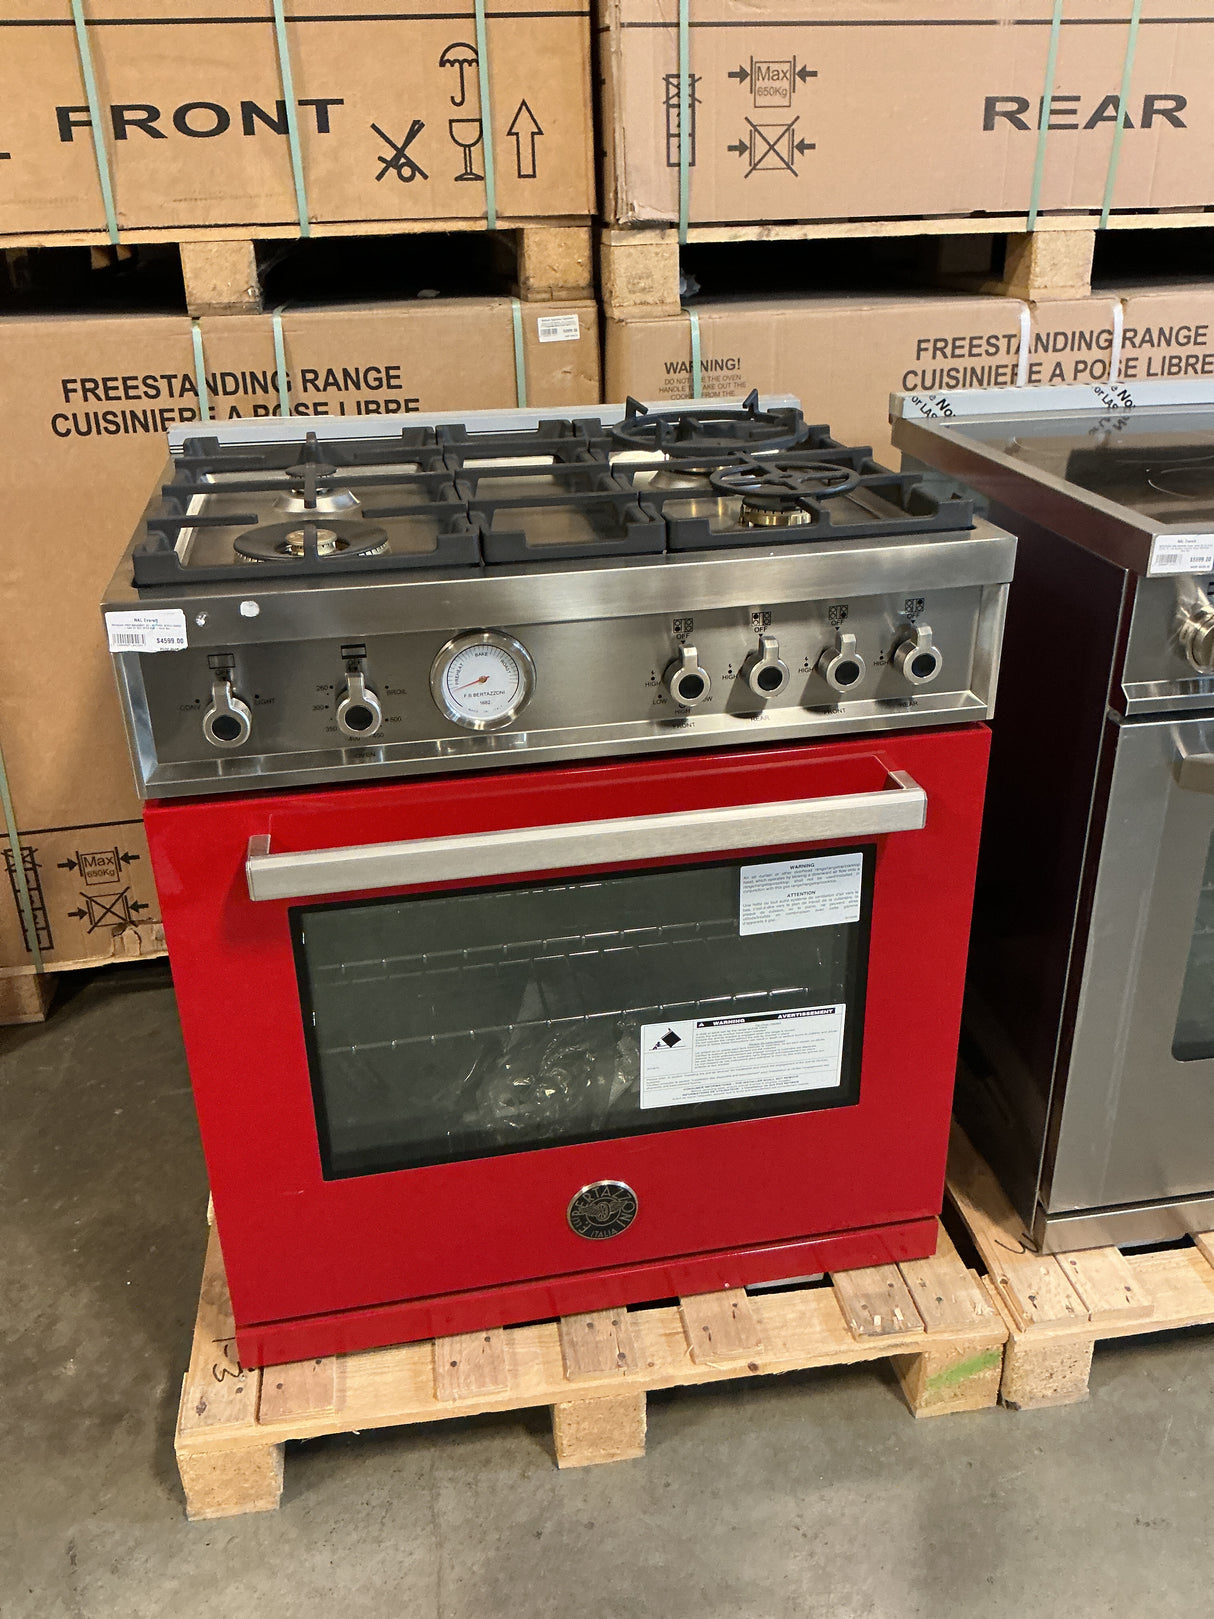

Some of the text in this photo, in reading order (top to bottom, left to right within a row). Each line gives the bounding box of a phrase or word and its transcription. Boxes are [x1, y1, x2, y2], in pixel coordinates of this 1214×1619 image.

[757, 65, 790, 81] Max
[757, 86, 788, 98] 650Kg
[55, 98, 344, 142] FRONT
[982, 93, 1188, 131] REAR
[1121, 324, 1209, 349] RANGE
[1048, 361, 1066, 382] A
[1146, 353, 1214, 377] LIBRE
[300, 365, 403, 393] RANGE
[83, 856, 114, 868] Max
[790, 862, 815, 870] WARNING
[787, 890, 817, 898] ATTENTION
[713, 1008, 834, 1026] WARNING AVERTISSEMENT
[591, 1228, 618, 1238] ITALIA
